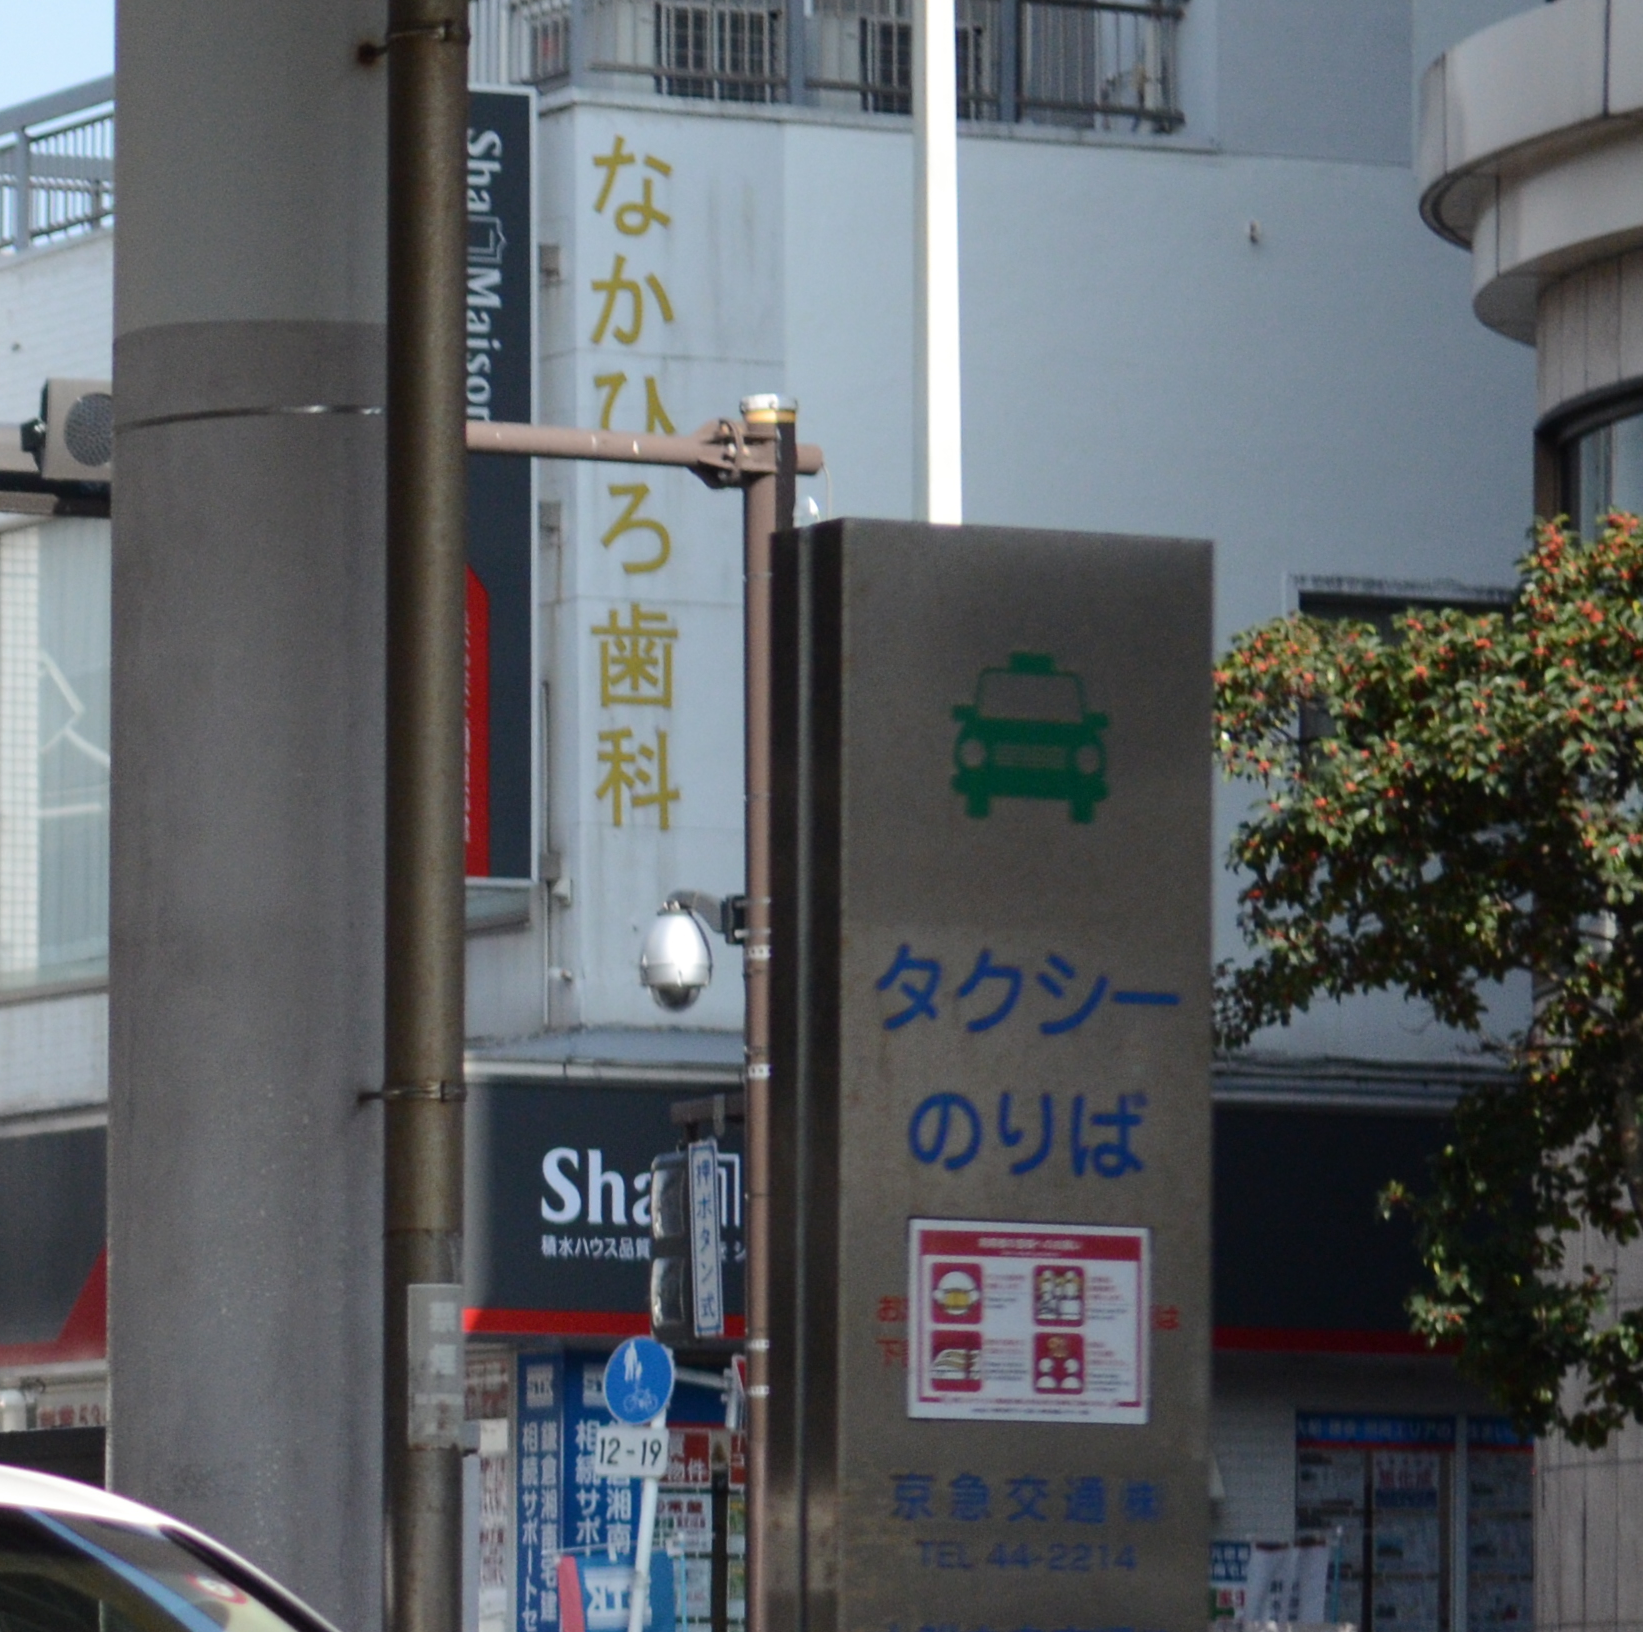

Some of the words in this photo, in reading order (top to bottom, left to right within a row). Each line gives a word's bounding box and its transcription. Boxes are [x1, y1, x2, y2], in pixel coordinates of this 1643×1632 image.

[590, 134, 680, 832] なかひろ歯科
[876, 939, 1180, 1036] タクシー
[907, 1090, 1147, 1180] のりば
[696, 1159, 716, 1319] 押ボタン式
[598, 1437, 663, 1467] 12-19
[916, 1541, 973, 1570] TEL
[986, 1541, 1138, 1572] 44-2214
